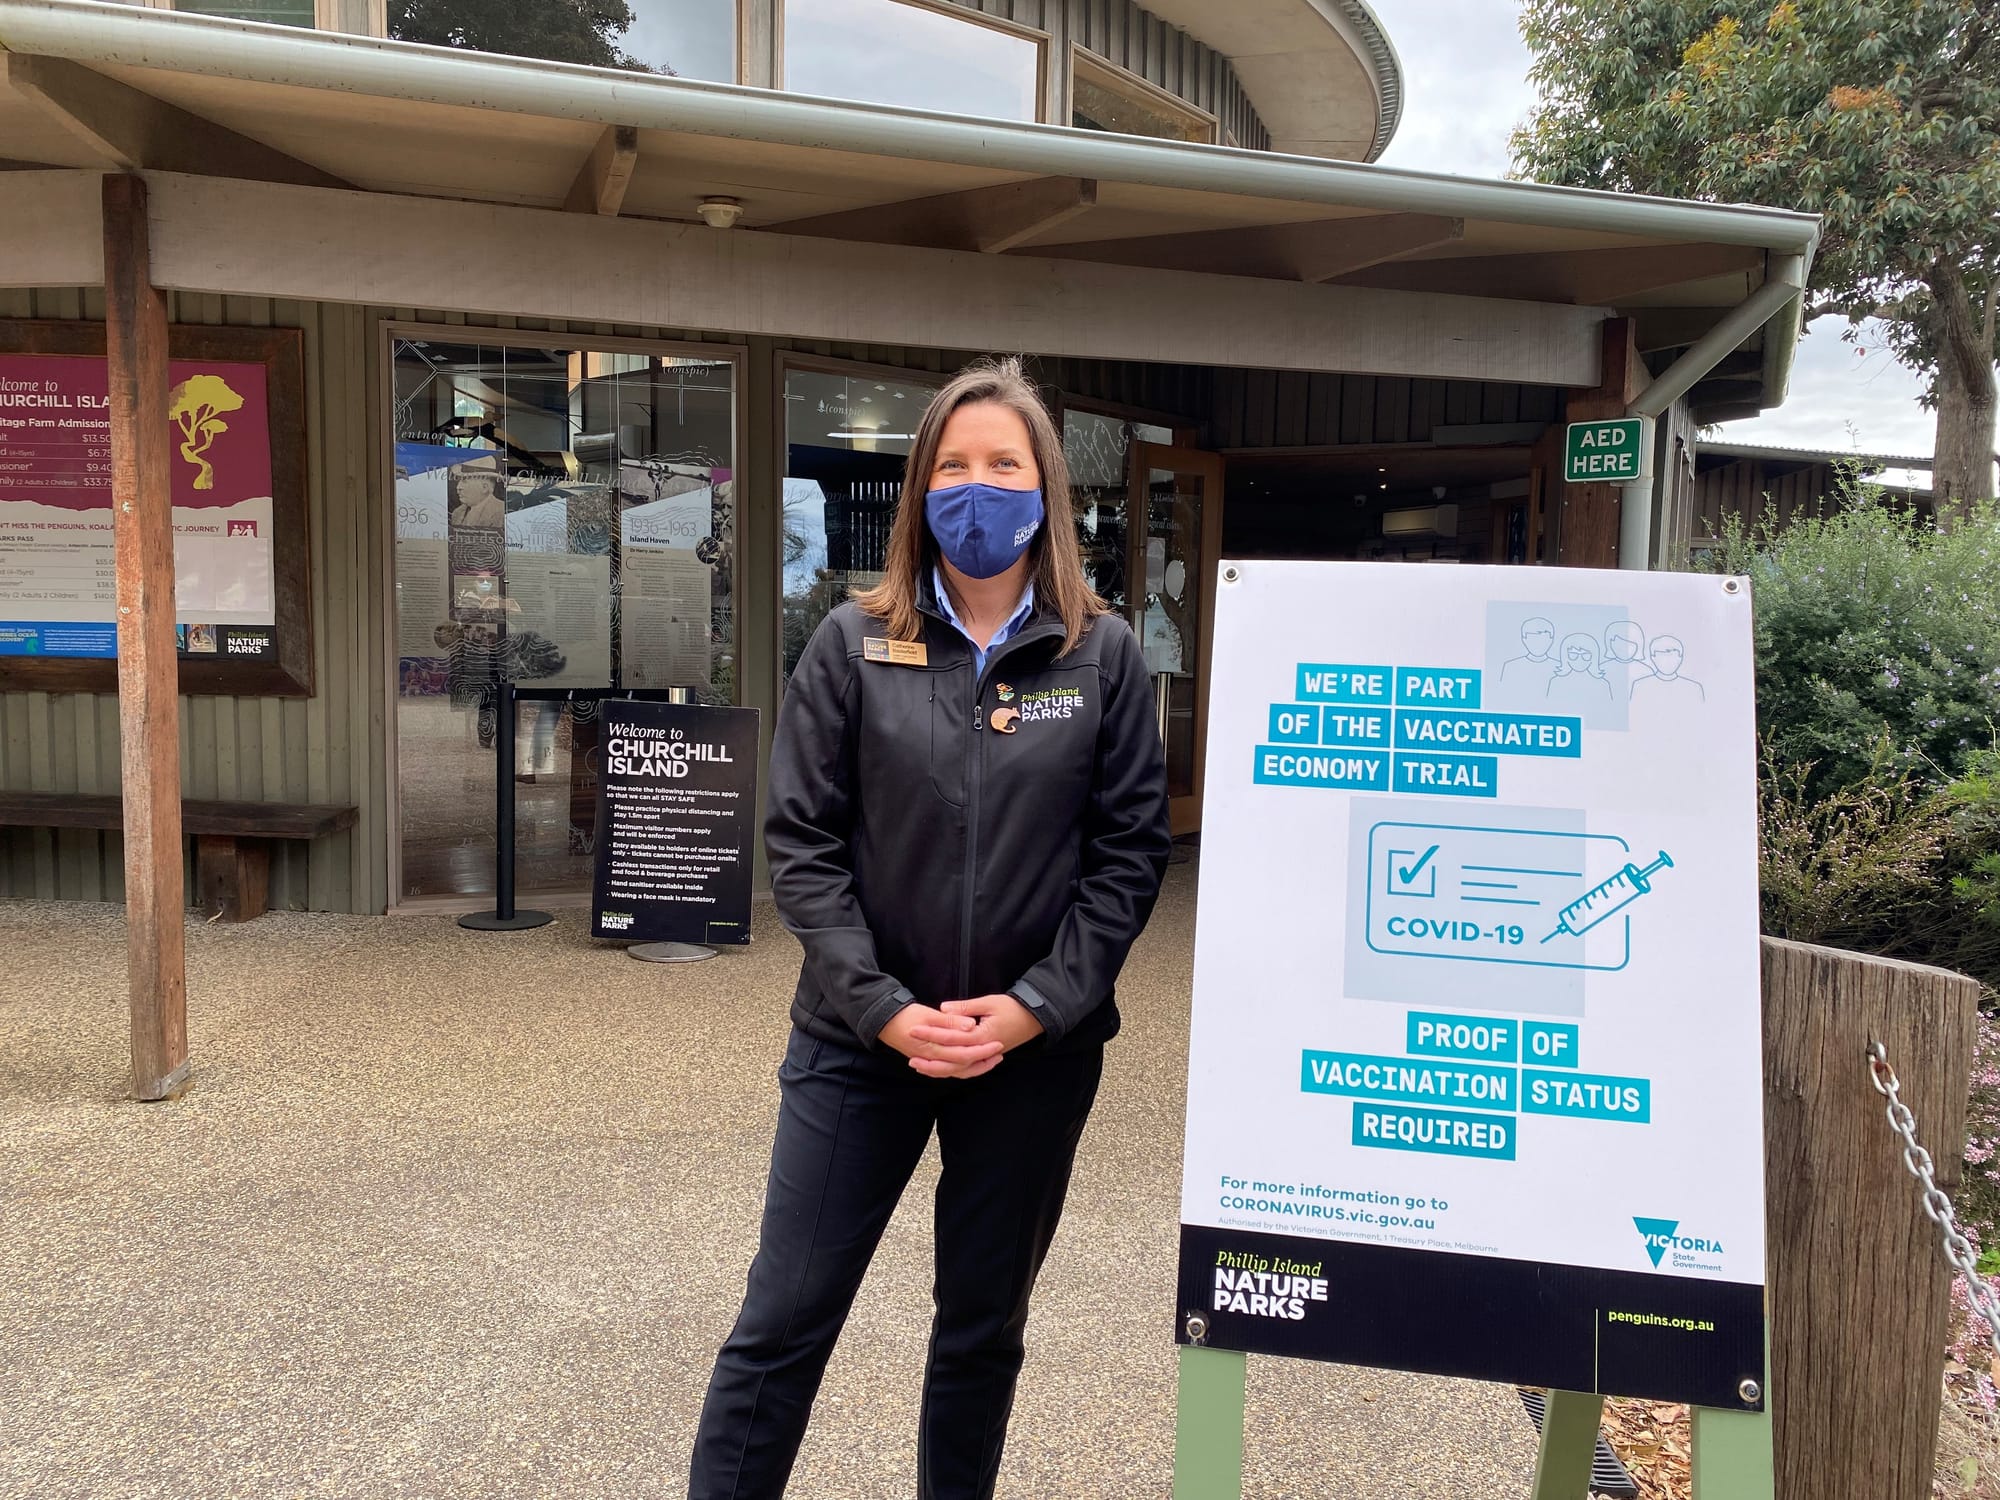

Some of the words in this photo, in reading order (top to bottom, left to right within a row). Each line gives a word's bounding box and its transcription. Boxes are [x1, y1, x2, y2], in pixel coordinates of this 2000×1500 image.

[0, 377, 38, 392] lcome
[45, 380, 58, 392] to
[76, 395, 110, 408] ISLA
[28, 418, 54, 428] Farm
[58, 418, 110, 428] Admission
[401, 430, 446, 441] entnor
[1580, 428, 1626, 448] AED
[1573, 452, 1632, 474] HERE
[399, 507, 428, 524] 936
[630, 536, 648, 544] Island
[228, 638, 270, 646] NATURE
[228, 645, 262, 654] PARKS
[1021, 691, 1050, 702] Phillip
[1050, 688, 1079, 696] Island
[1304, 672, 1383, 696] WE'RE
[1406, 676, 1472, 699] PART
[1022, 696, 1084, 712] NATURE
[1022, 706, 1072, 722] PARKS
[608, 722, 666, 739] Welcome
[670, 728, 684, 740] to
[1278, 714, 1310, 734] OF
[1332, 715, 1381, 738] THE
[1404, 718, 1572, 748] VACCINATED
[608, 738, 733, 762] CHURCHILL
[608, 756, 688, 778] ISLAND
[1264, 754, 1380, 782] ECONOMY
[1402, 761, 1488, 788] TRIAL
[655, 786, 684, 796] following
[685, 788, 720, 797] restrictions
[662, 806, 687, 814] physical
[688, 808, 720, 816] distancing
[640, 862, 677, 870] transactions
[610, 892, 637, 900] Wearing
[602, 916, 634, 924] NATURE
[1387, 916, 1524, 946] COVID-19
[1418, 1021, 1507, 1052] PROOF
[1532, 1031, 1568, 1056] OF
[1311, 1060, 1507, 1100] VACCINATION
[1532, 1080, 1640, 1112] STATUS
[1362, 1112, 1506, 1149] REQUIRED
[1221, 1176, 1247, 1190] For
[1253, 1182, 1295, 1194] more
[1300, 1184, 1400, 1206] information
[1405, 1198, 1426, 1210] go
[1431, 1198, 1448, 1210] to
[1220, 1196, 1435, 1230] CORONAVIRUS.vic.gov.au
[1218, 1217, 1262, 1228] Authorised
[1264, 1220, 1274, 1230] by
[1276, 1223, 1288, 1232] the
[1291, 1224, 1328, 1235] Victorian
[1330, 1228, 1382, 1240] Government,
[1390, 1235, 1426, 1246] Treasury
[1428, 1238, 1452, 1248] Place,
[1455, 1242, 1498, 1253] Melbourne
[1640, 1233, 1724, 1254] VICTORIA
[1216, 1250, 1268, 1274] Phillip
[1273, 1256, 1321, 1276] Island
[1672, 1260, 1722, 1272] Government
[1673, 1252, 1695, 1262] State
[1214, 1268, 1328, 1300] NATURE
[1214, 1290, 1304, 1320] PARKS
[1608, 1311, 1714, 1331] penguins.org.au
